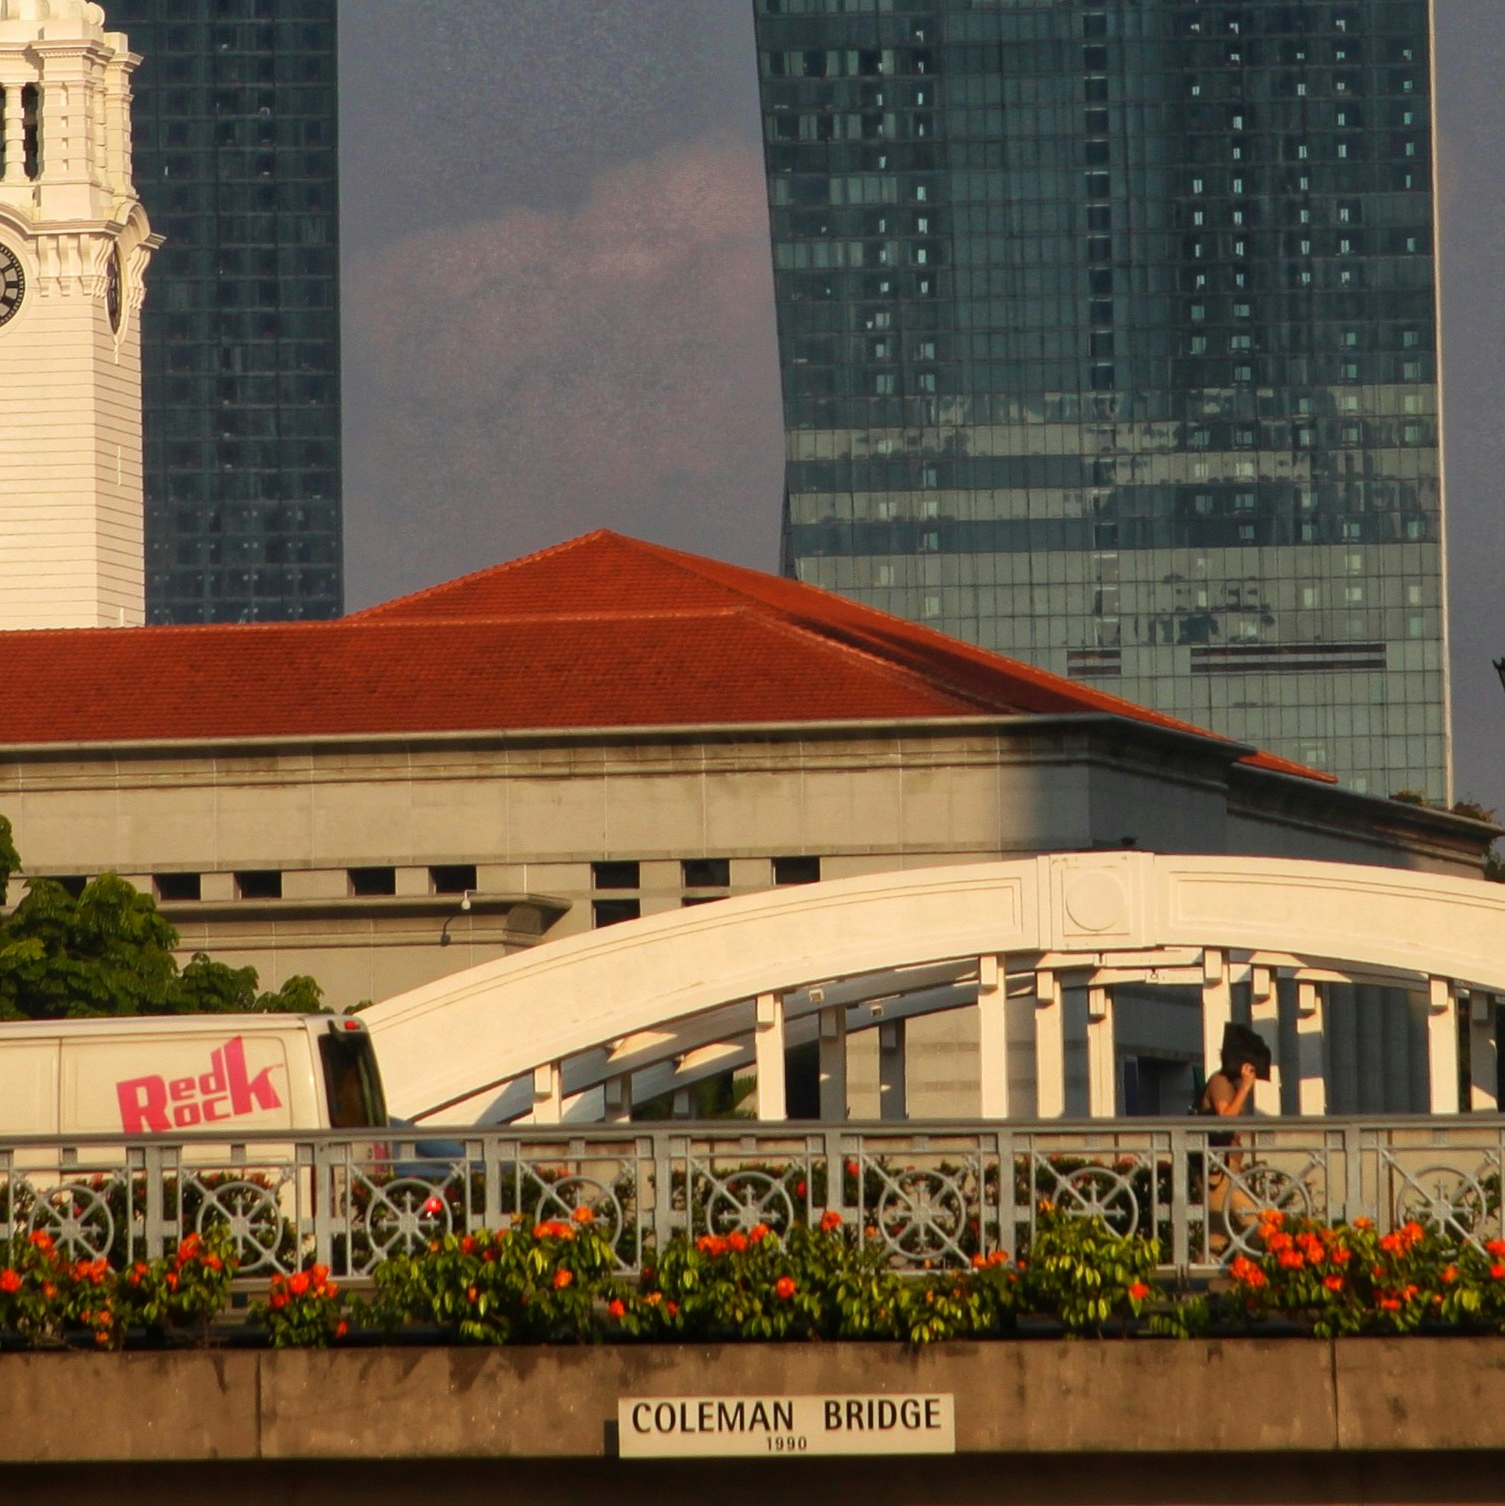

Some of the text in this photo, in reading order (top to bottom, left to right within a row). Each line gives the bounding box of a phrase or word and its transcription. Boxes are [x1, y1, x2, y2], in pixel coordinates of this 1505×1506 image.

[632, 1398, 942, 1433] COLEMAN BRIDGE
[766, 1436, 808, 1452] 1990
